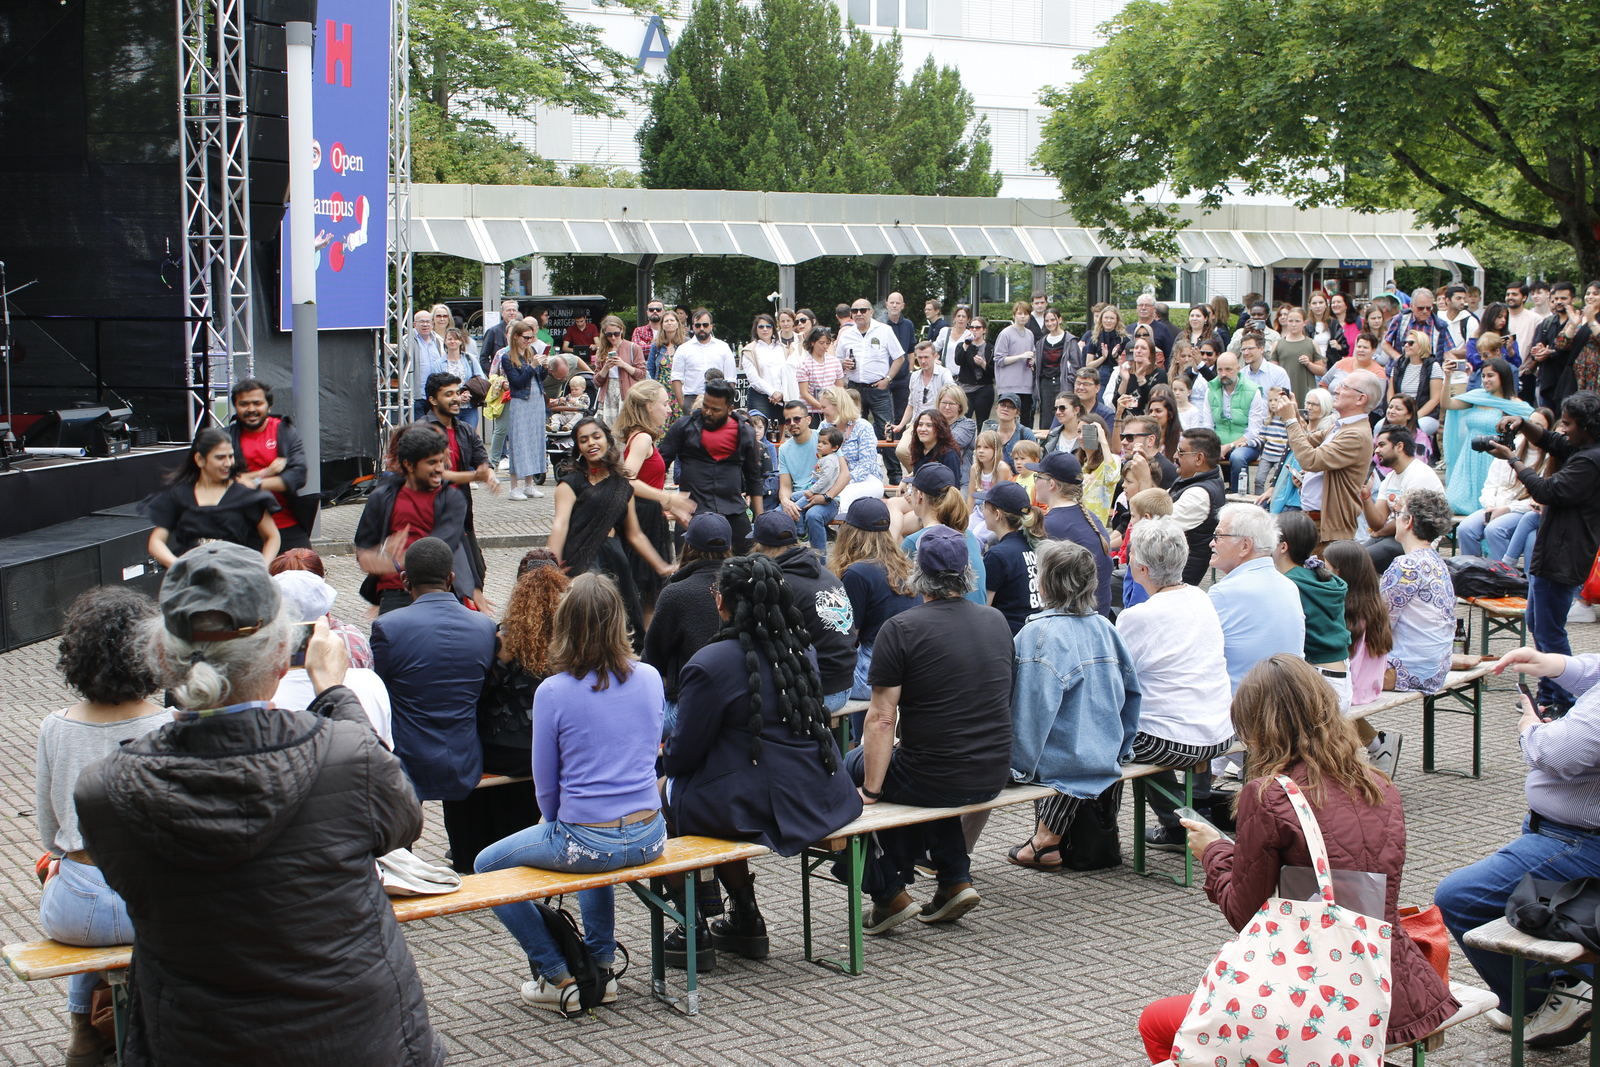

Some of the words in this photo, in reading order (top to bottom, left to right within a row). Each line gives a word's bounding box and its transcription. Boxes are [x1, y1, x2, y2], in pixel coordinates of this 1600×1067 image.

[634, 16, 672, 74] A
[332, 148, 363, 176] Open
[313, 198, 354, 223] ampus
[1022, 550, 1037, 566] HO
[1027, 565, 1038, 578] SC
